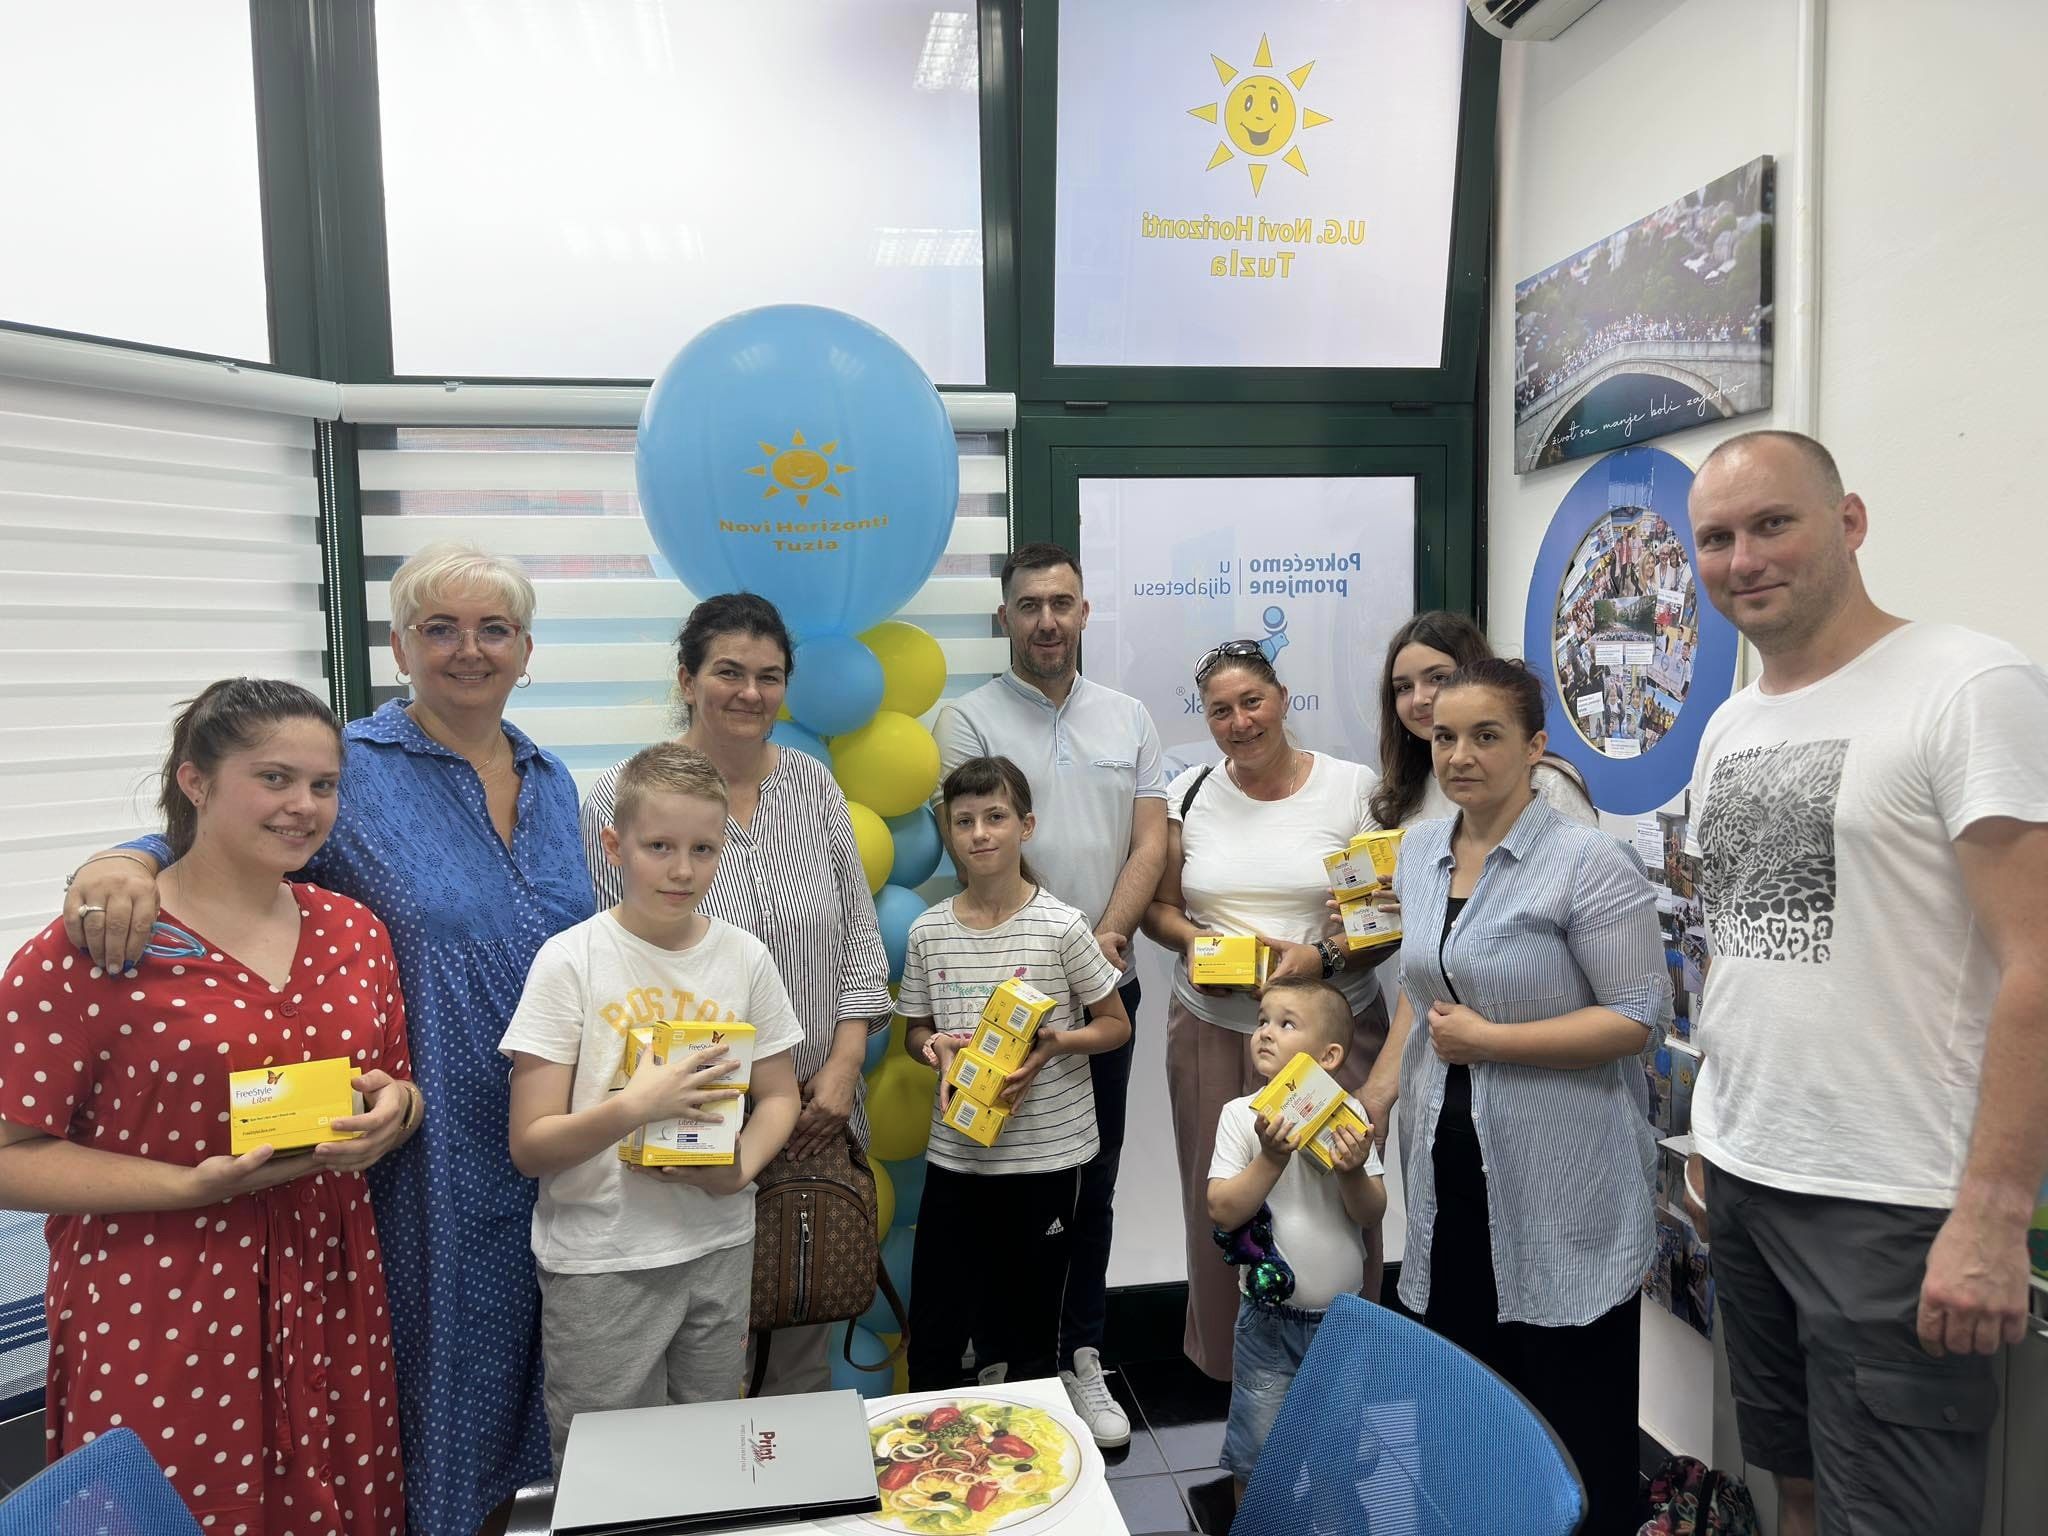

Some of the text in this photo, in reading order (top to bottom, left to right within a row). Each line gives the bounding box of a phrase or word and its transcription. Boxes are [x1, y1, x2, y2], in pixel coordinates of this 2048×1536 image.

[1579, 427, 1597, 439] sa
[1603, 413, 1645, 437] manje
[1650, 394, 1682, 418] boli
[1687, 376, 1746, 417] zajedno
[719, 514, 889, 534] Novi Horizonti
[773, 538, 840, 553] Tuzla
[598, 986, 736, 1038] BOSTO
[235, 1086, 273, 1099] FreeStyle
[252, 1096, 273, 1105] Libre
[759, 1431, 776, 1461] Print
